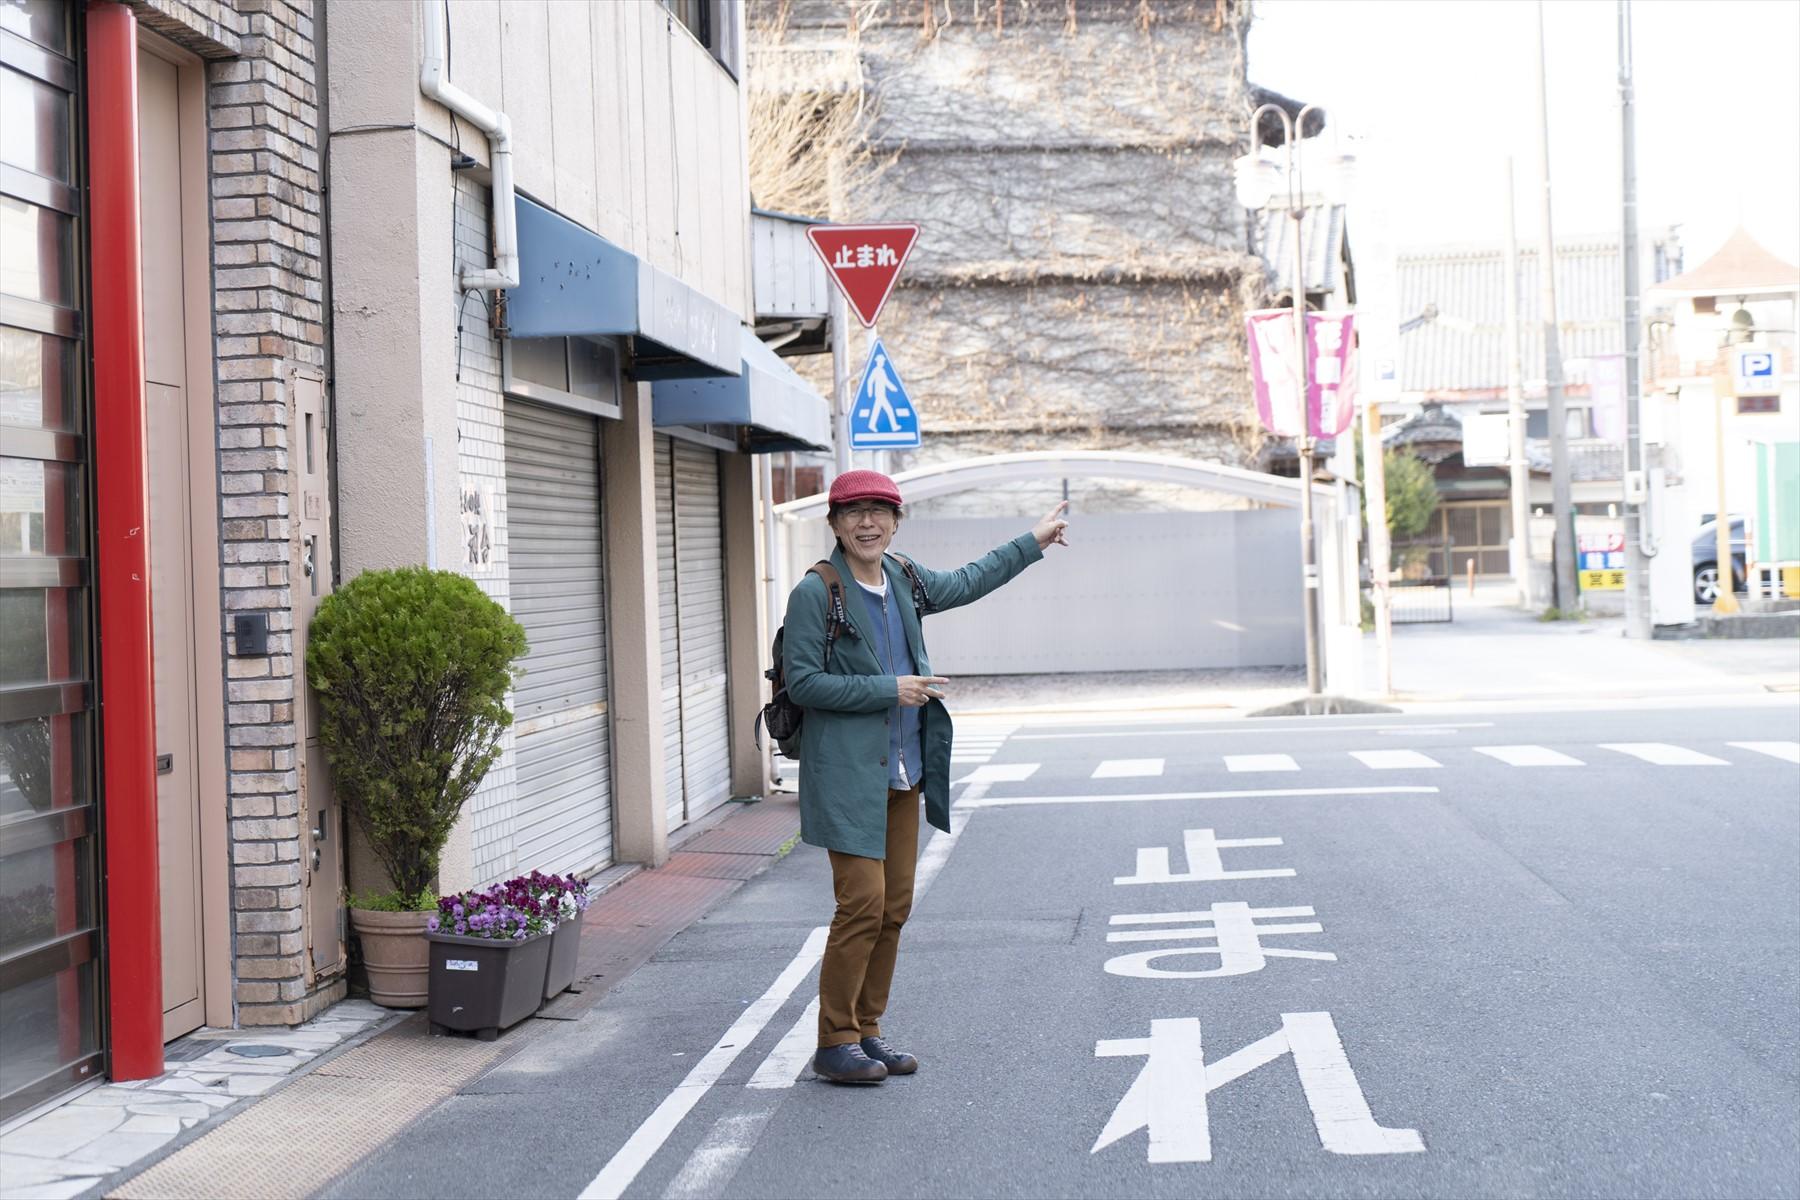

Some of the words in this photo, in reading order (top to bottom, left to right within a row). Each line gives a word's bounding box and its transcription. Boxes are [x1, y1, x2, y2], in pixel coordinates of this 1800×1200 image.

[833, 243, 899, 269] 止まれ
[1744, 355, 1770, 376] P
[834, 596, 846, 623] MILLET
[1090, 828, 1426, 1163] 止まれ
